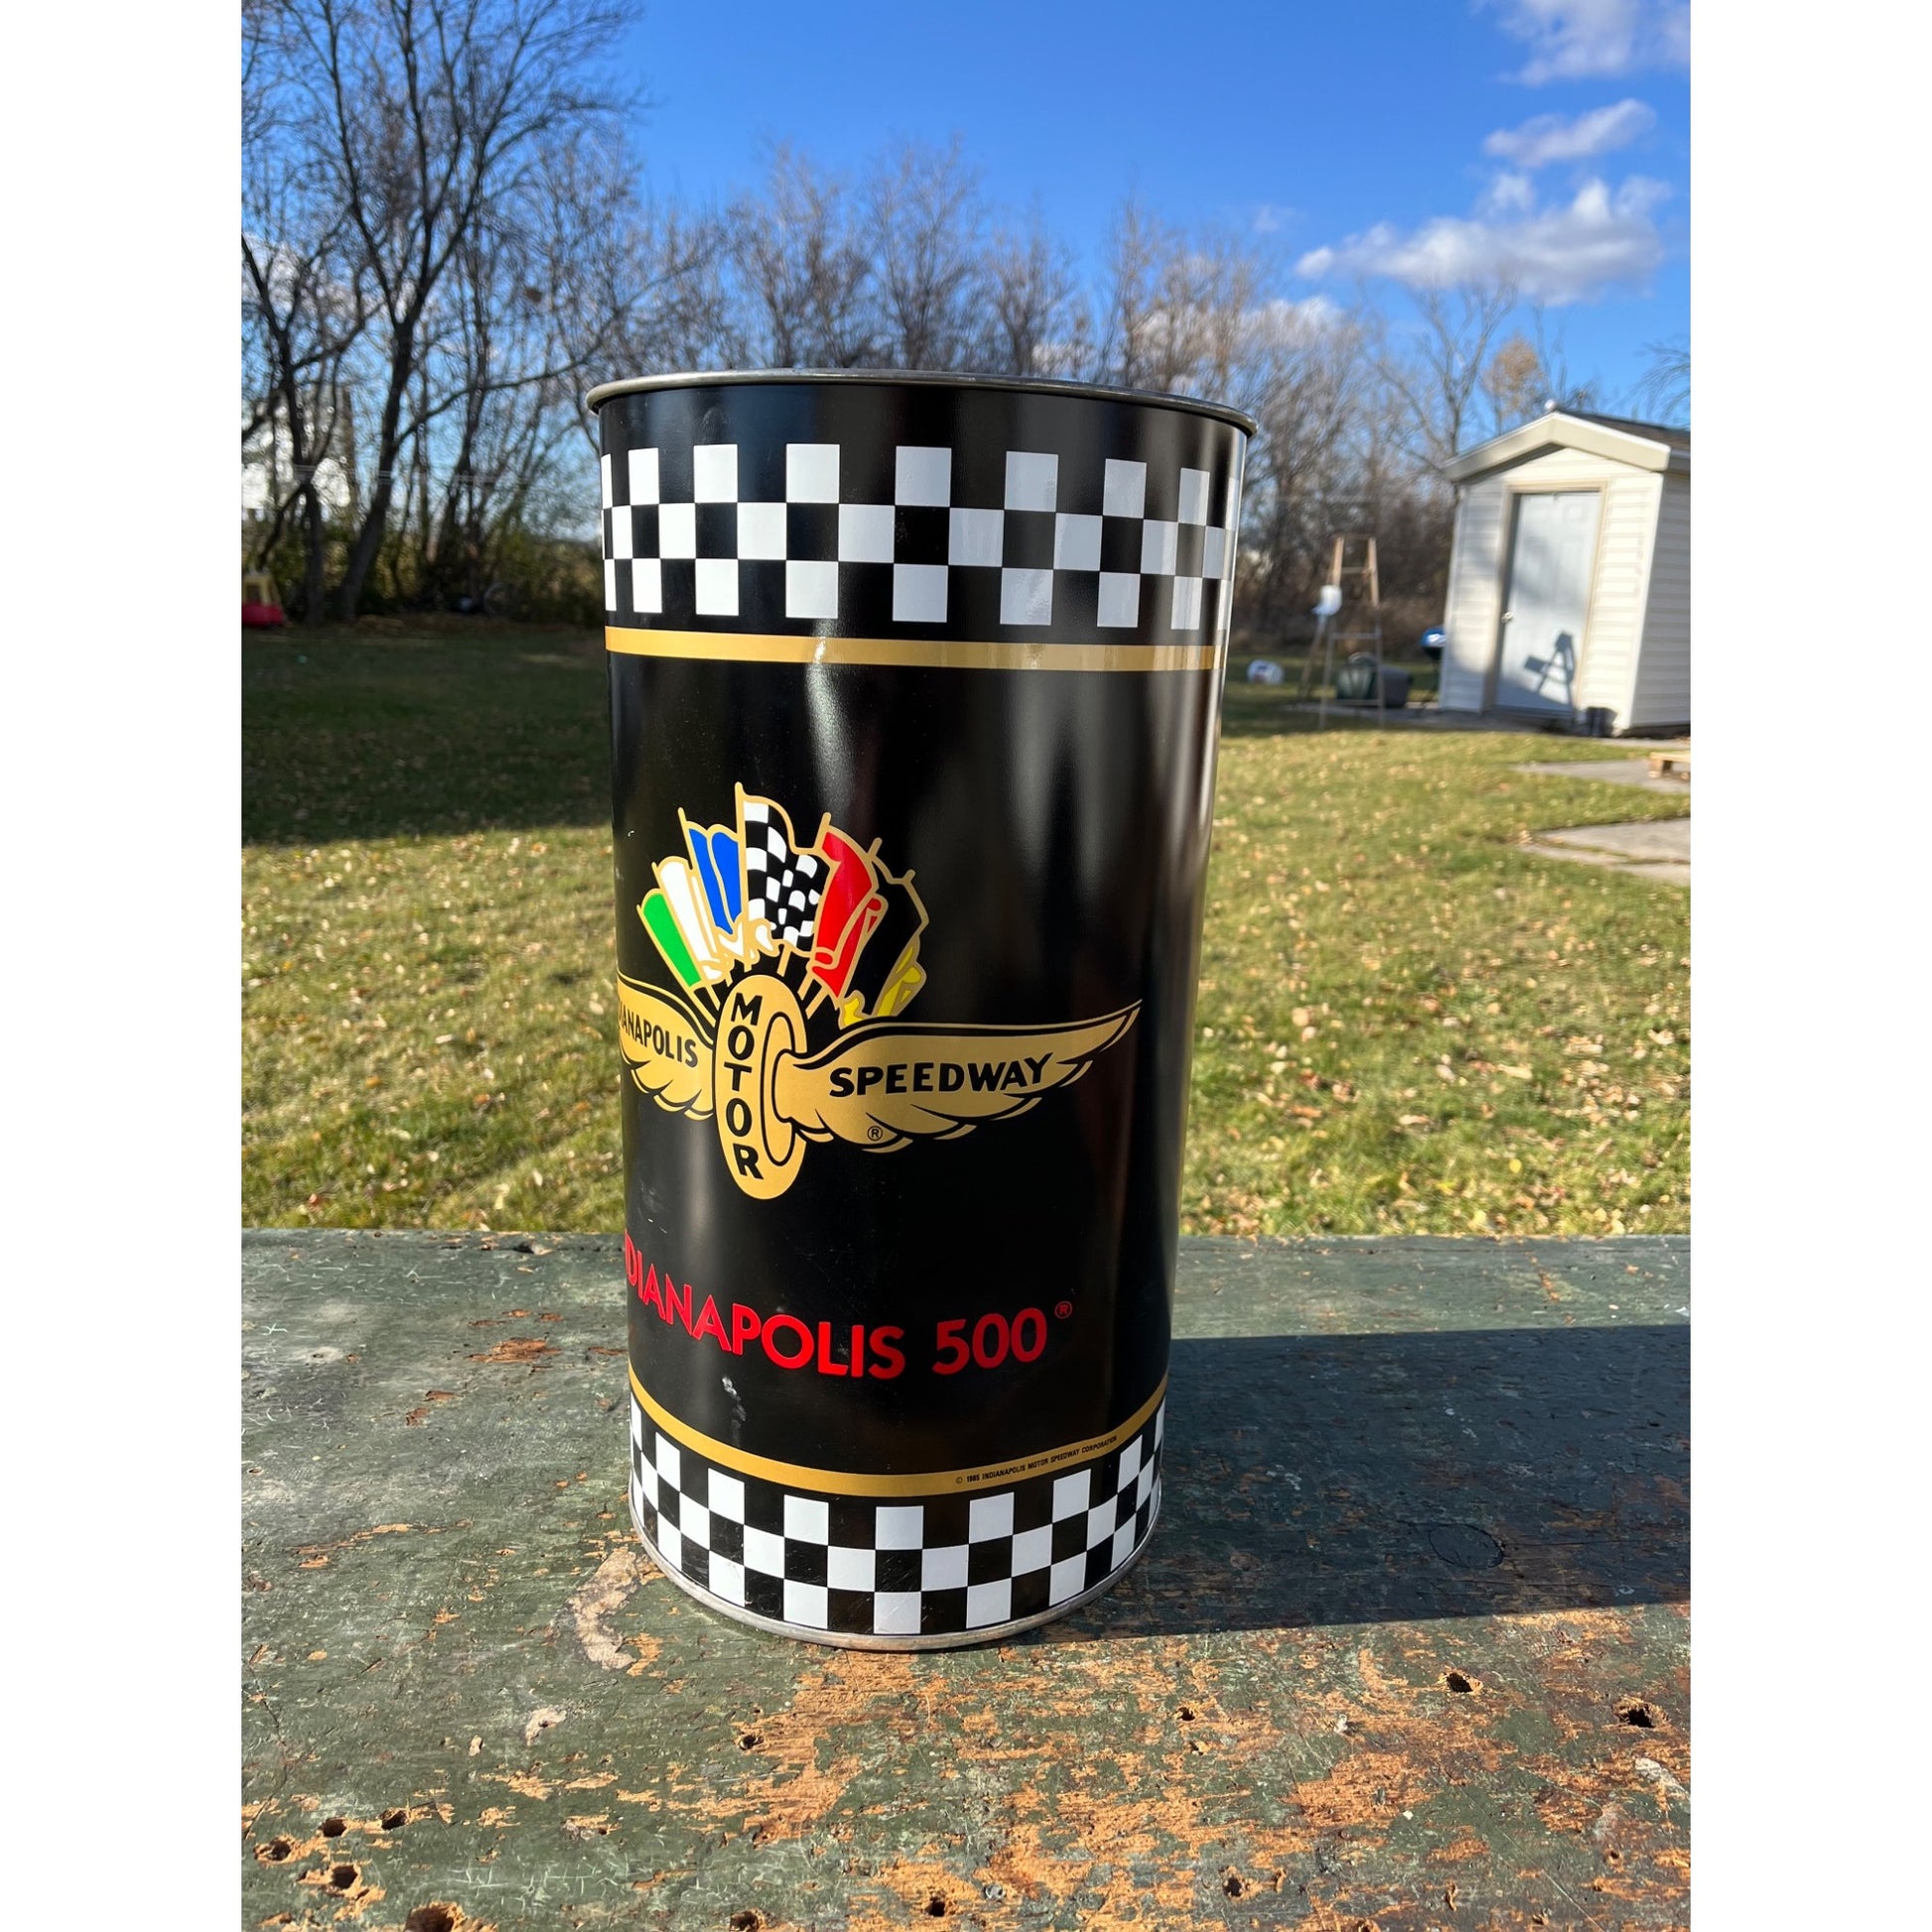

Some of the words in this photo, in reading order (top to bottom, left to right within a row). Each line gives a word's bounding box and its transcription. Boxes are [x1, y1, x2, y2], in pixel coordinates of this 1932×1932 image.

[724, 992, 764, 1180] MOTOR
[829, 1052, 1054, 1098] SPEEDWAY
[624, 1228, 905, 1379] DIANAPOLIS
[932, 1308, 1047, 1375] 500
[982, 1464, 1027, 1480] INDIANAPOLIS
[1027, 1456, 1049, 1470] MOTOR
[1050, 1449, 1080, 1463] SPEEDWAY
[1081, 1436, 1118, 1453] CORPORATION
